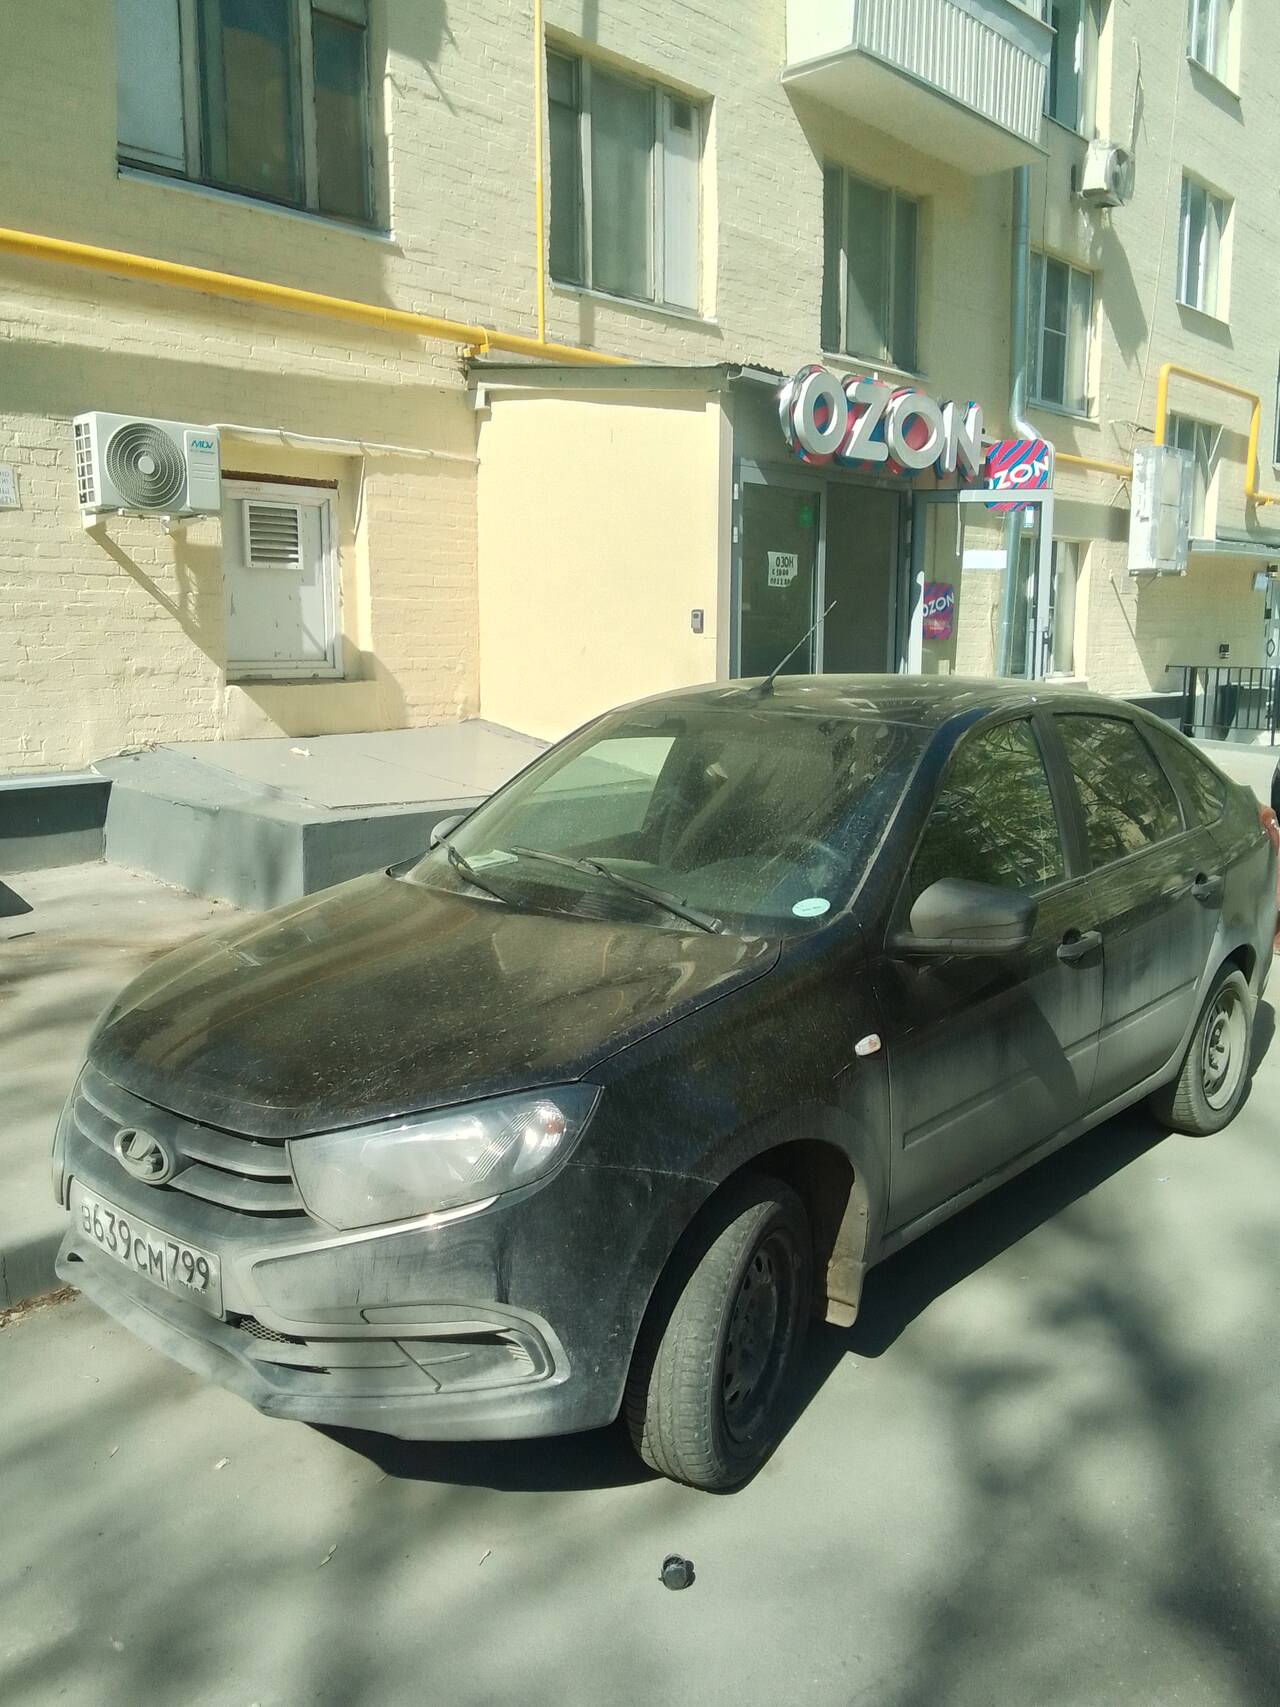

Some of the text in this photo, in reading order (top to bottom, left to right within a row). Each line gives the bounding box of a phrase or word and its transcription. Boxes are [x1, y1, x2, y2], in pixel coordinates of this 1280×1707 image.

[793, 369, 984, 478] OZON
[191, 439, 214, 449] MDV
[989, 456, 1049, 489] ZON
[922, 592, 955, 617] OZON
[167, 1242, 210, 1290] 799
